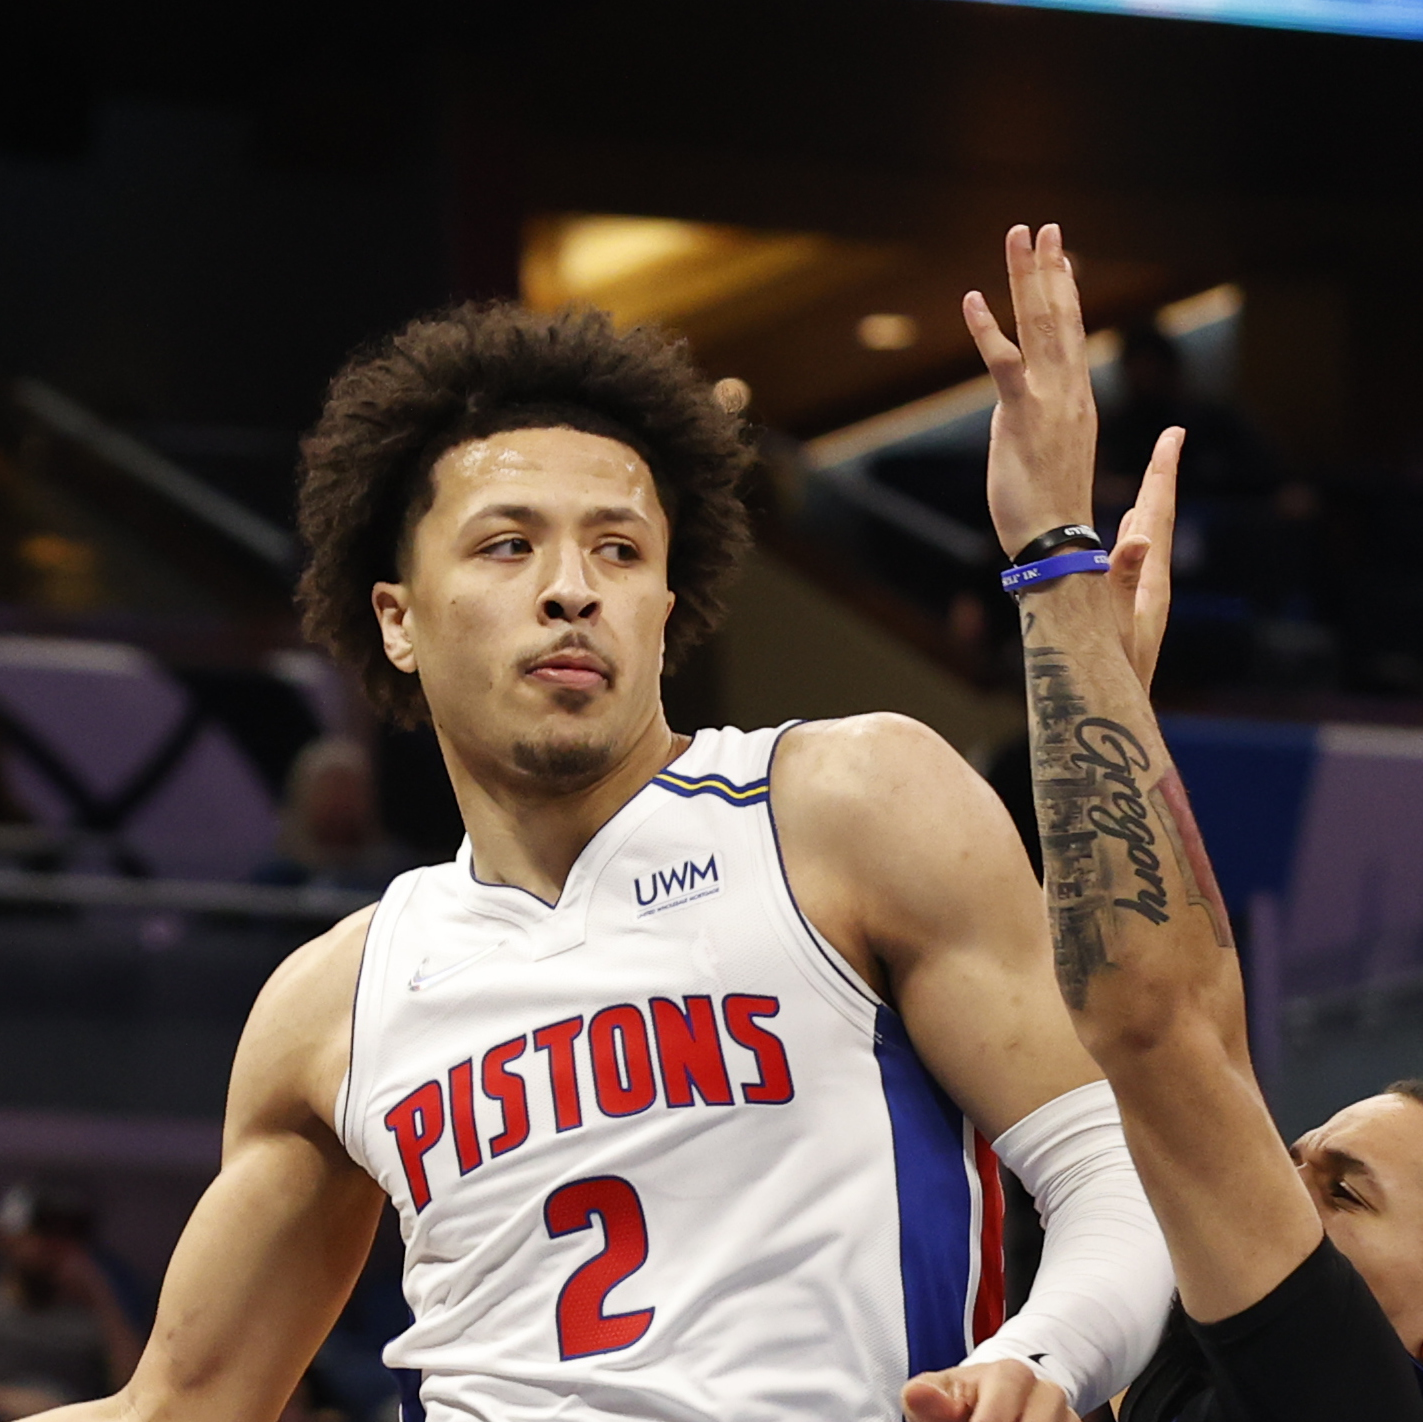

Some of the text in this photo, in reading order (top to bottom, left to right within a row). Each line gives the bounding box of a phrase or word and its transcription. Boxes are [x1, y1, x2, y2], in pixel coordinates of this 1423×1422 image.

[634, 851, 719, 907] UWM
[1072, 715, 1172, 927] Gregory
[384, 993, 795, 1215] PISTONS
[543, 1174, 656, 1362] 2
